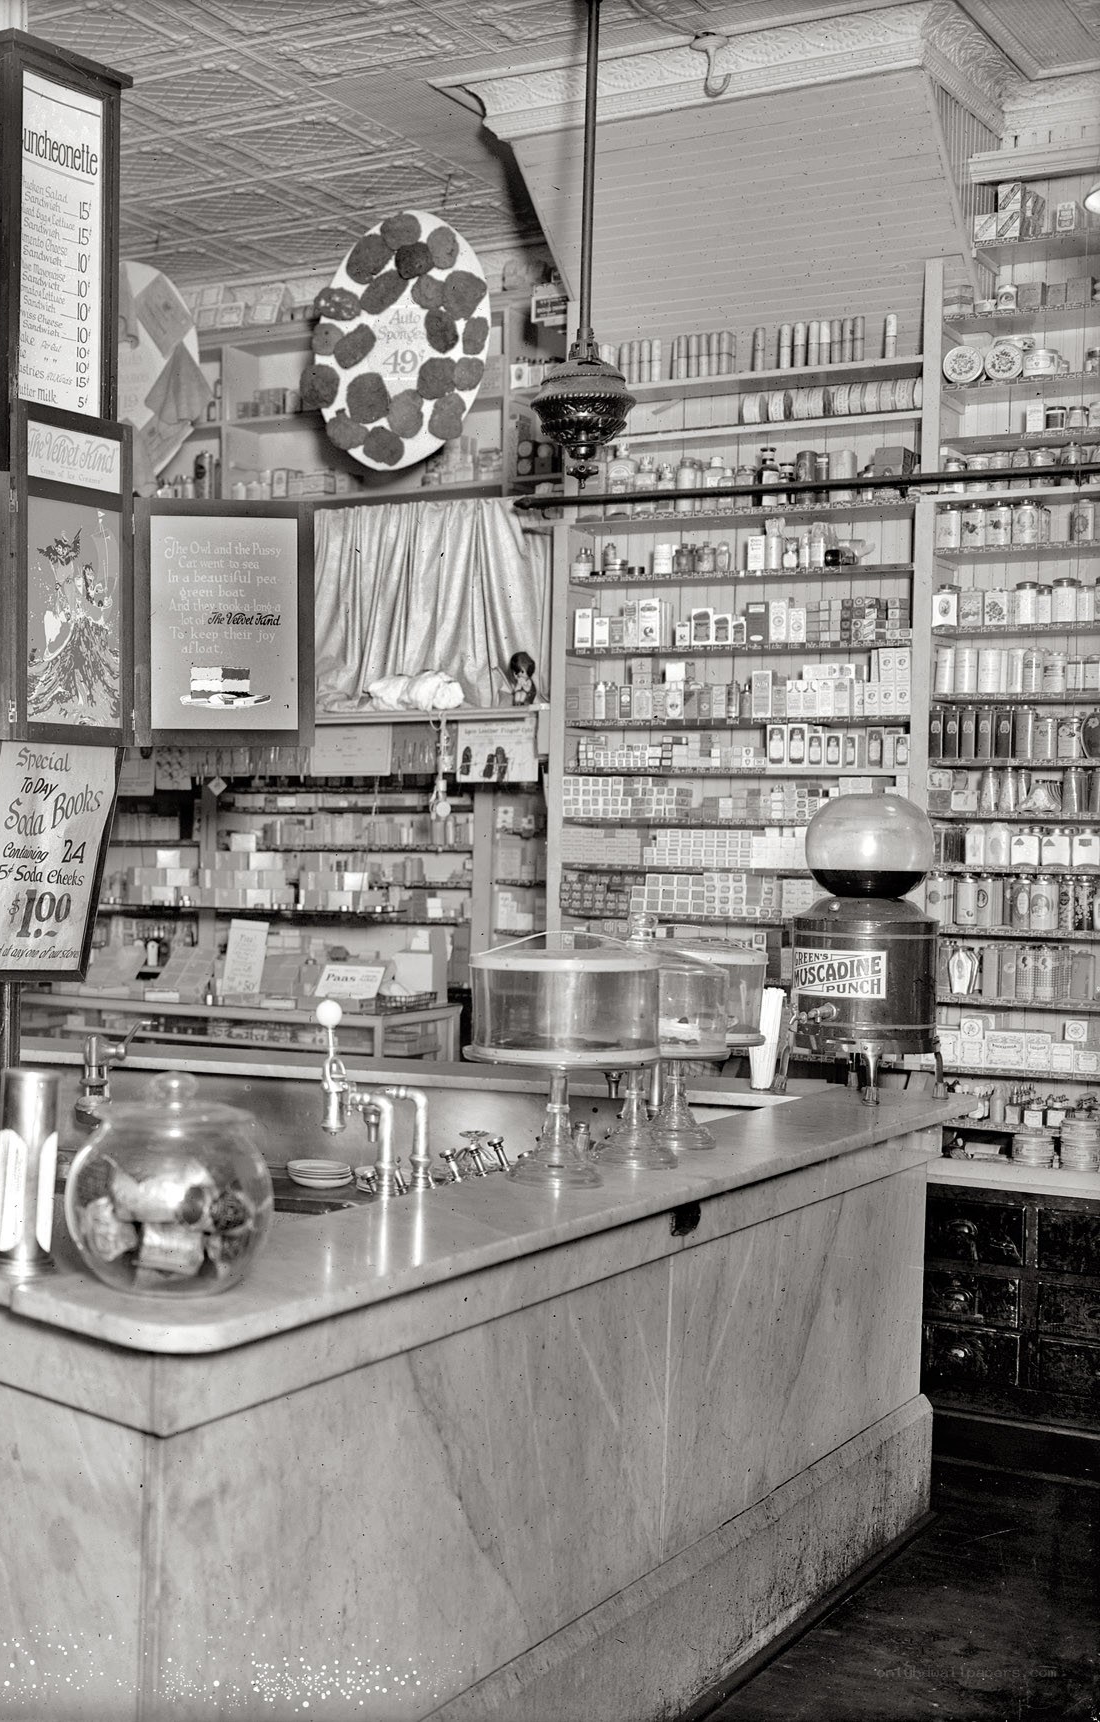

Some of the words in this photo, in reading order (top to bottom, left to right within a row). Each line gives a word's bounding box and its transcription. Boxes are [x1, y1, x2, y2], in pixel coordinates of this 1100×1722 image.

[24, 190, 62, 213] Sandwich
[45, 186, 68, 204] Salad
[24, 216, 60, 240] Sandwich
[23, 244, 62, 267] Sandwich
[22, 270, 61, 291] Sandwich
[23, 294, 56, 314] Sandwich
[37, 313, 63, 329] Cheese
[390, 309, 421, 325] Auto
[22, 319, 60, 338] Sandwich
[377, 325, 427, 344] Sponges
[19, 382, 36, 398] utter
[37, 387, 58, 404] Milk
[44, 431, 80, 467] Velvet
[164, 536, 189, 559] The
[189, 541, 211, 555] Owl
[213, 542, 232, 555] and
[234, 542, 251, 555] the
[252, 542, 282, 558] Pussy
[179, 555, 197, 568] Cat
[200, 558, 225, 569] went
[226, 559, 240, 569] to
[242, 560, 260, 569] sea
[168, 569, 179, 583] In
[182, 575, 189, 583] a
[194, 570, 251, 584] beautiful
[179, 587, 214, 600] green
[218, 585, 246, 598] boat
[169, 598, 190, 612] And
[193, 598, 216, 614] they
[180, 612, 194, 625] lot
[195, 612, 208, 625] of
[207, 611, 225, 625] The
[225, 611, 255, 626] Velvet
[169, 626, 185, 640] To
[190, 626, 219, 642] keep
[223, 626, 253, 640] their
[256, 630, 276, 643] joy
[16, 746, 71, 773] Special
[20, 776, 34, 794] To
[33, 777, 59, 801] DAY
[4, 797, 47, 837] Soda
[50, 783, 104, 830] Books
[2, 841, 50, 864] Containing
[61, 839, 87, 864] 24
[14, 864, 44, 883] Soda
[325, 973, 356, 982] Paas
[793, 955, 882, 988] MUSCADINE
[825, 977, 882, 995] PUNCH
